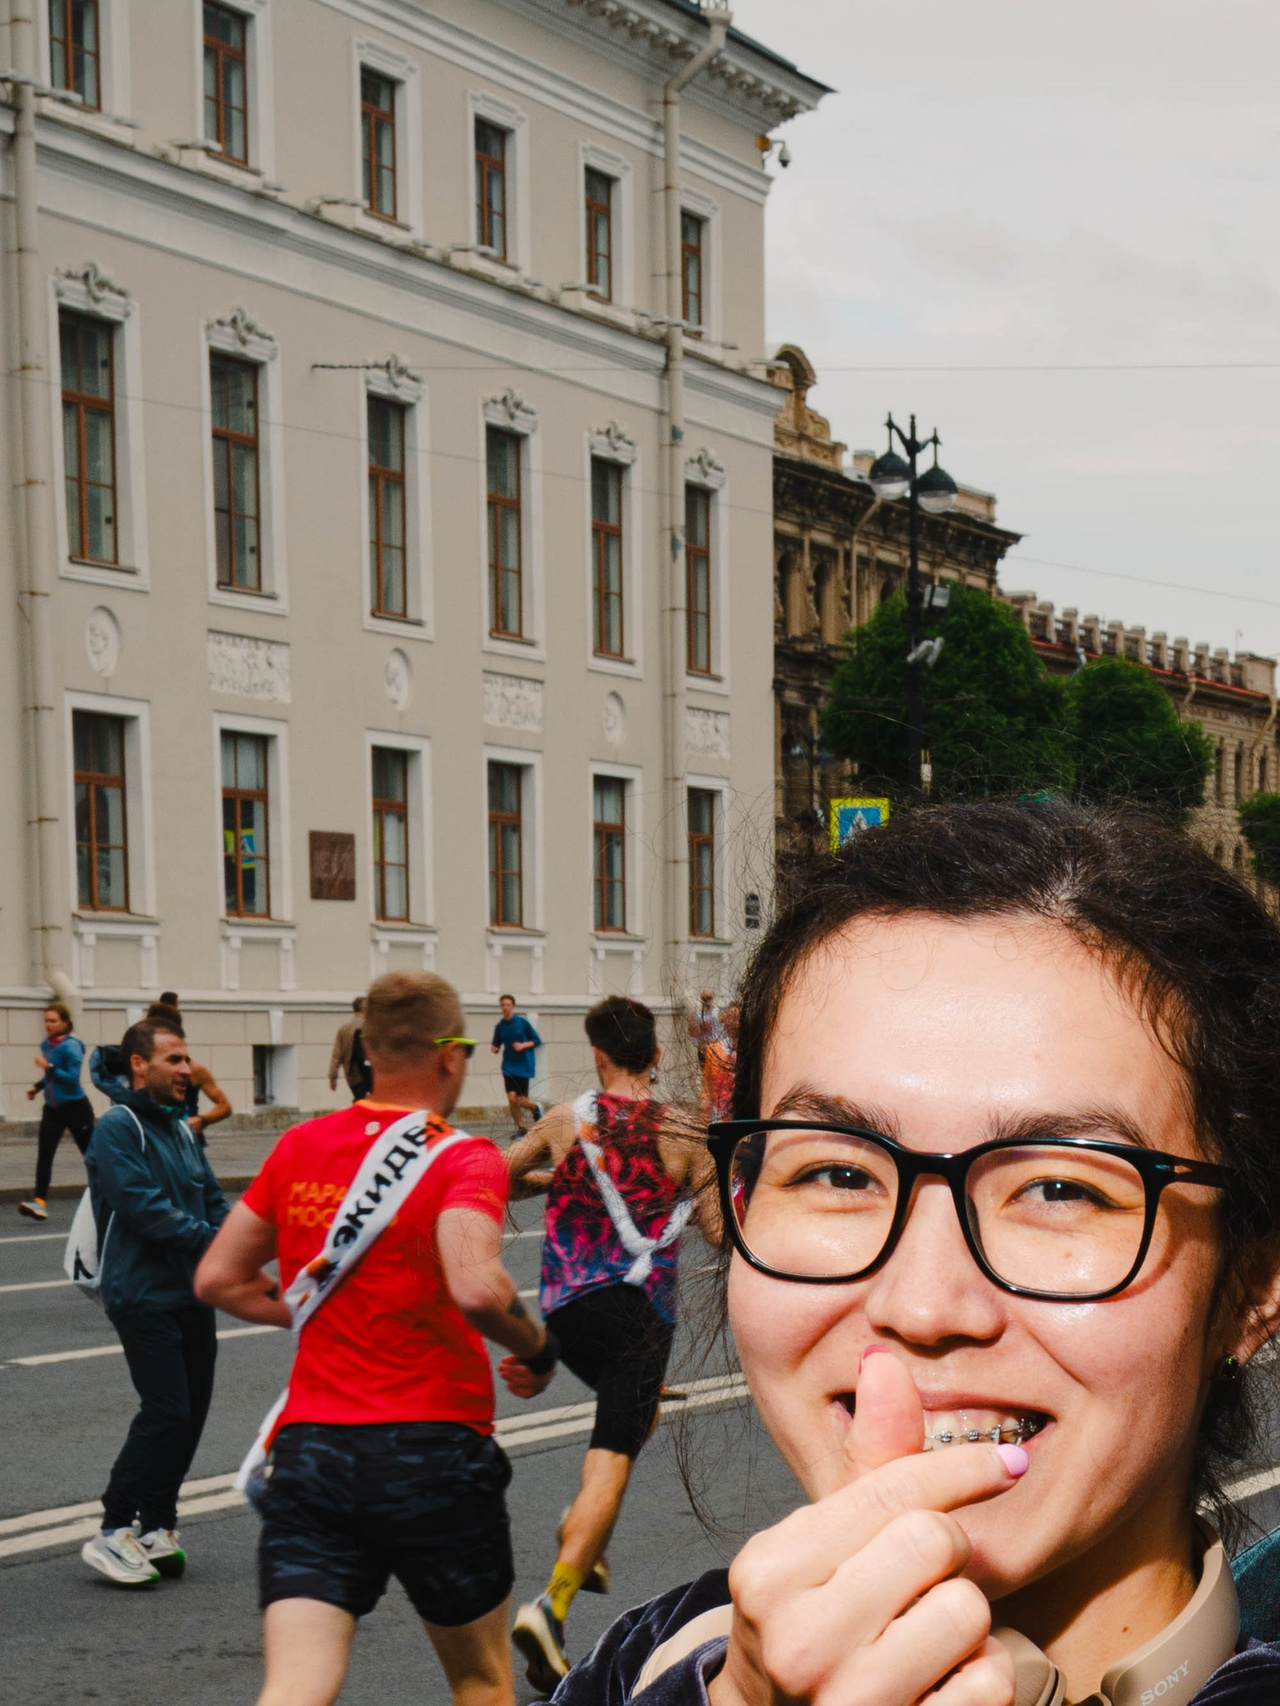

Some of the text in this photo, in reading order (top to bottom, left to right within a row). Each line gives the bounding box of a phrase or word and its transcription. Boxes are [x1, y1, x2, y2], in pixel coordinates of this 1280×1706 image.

[288, 1181, 348, 1204] МАРА
[286, 1205, 337, 1229] МОС
[1140, 1659, 1190, 1706] SONY
